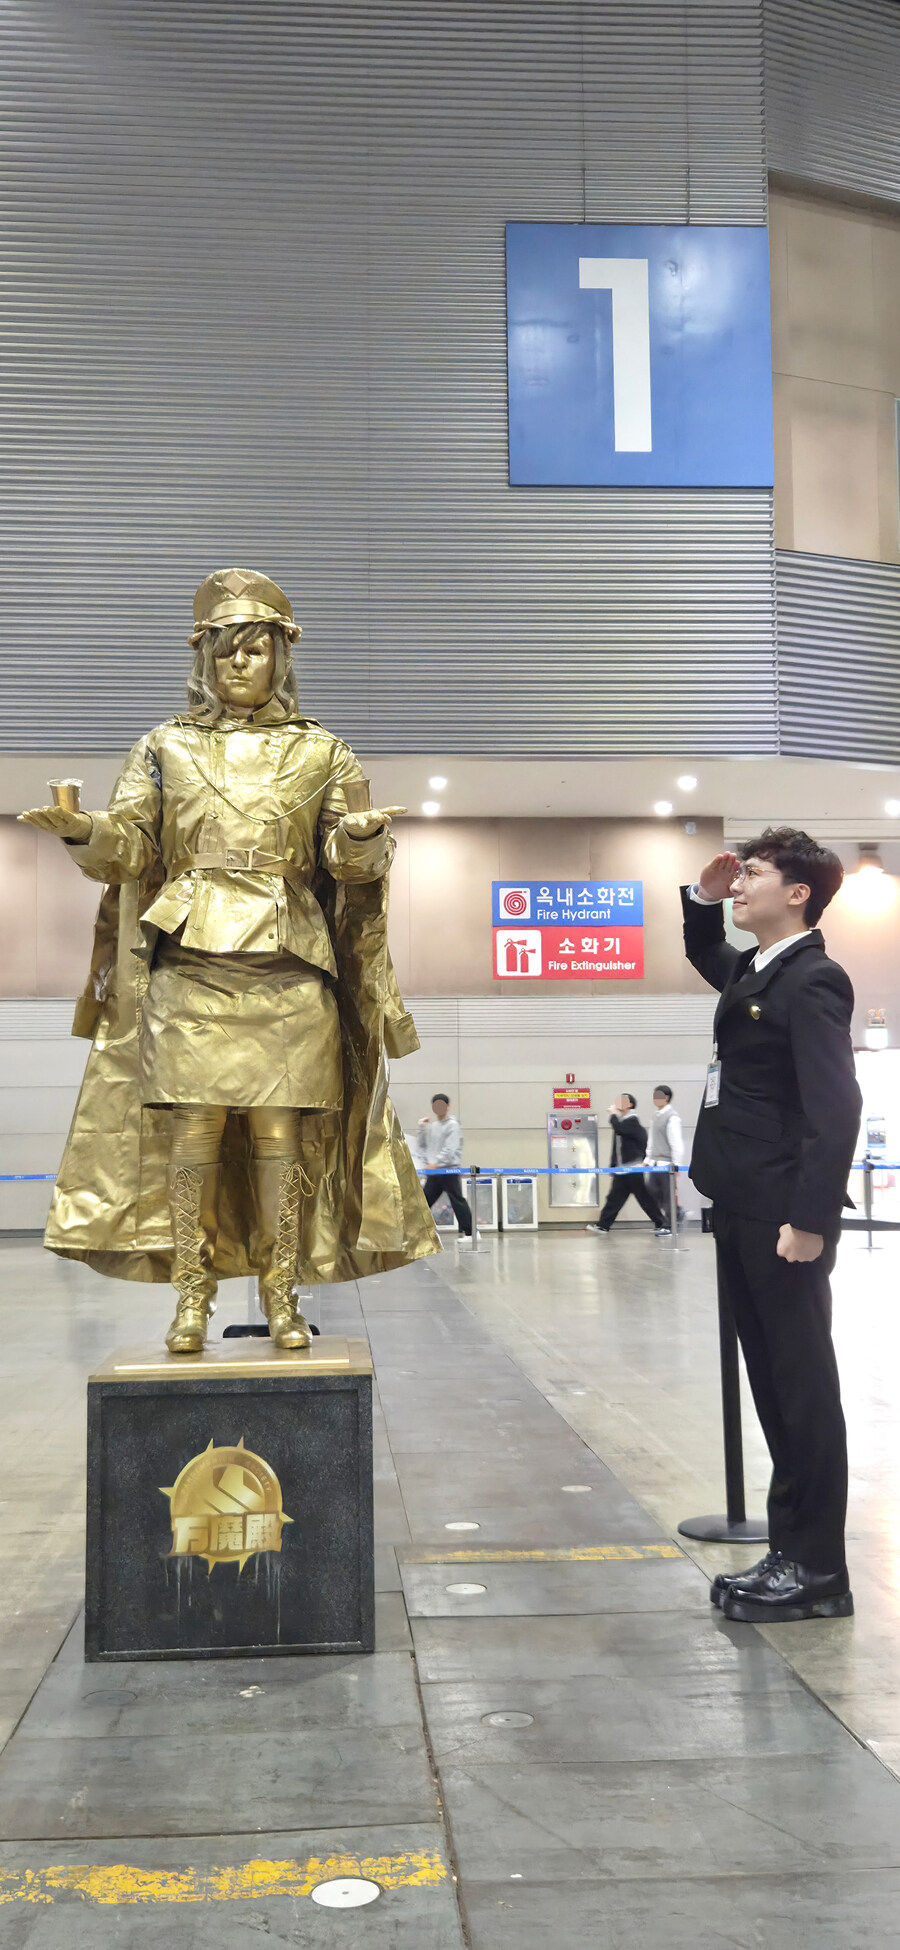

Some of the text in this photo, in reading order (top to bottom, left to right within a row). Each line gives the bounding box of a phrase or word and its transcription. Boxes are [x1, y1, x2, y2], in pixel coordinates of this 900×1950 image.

[579, 257, 652, 452] 1
[536, 887, 635, 906] 옥내소화전
[537, 908, 611, 921] Fire Hydrant
[558, 937, 621, 955] 소화기
[548, 960, 636, 972] Fire Extinguisher
